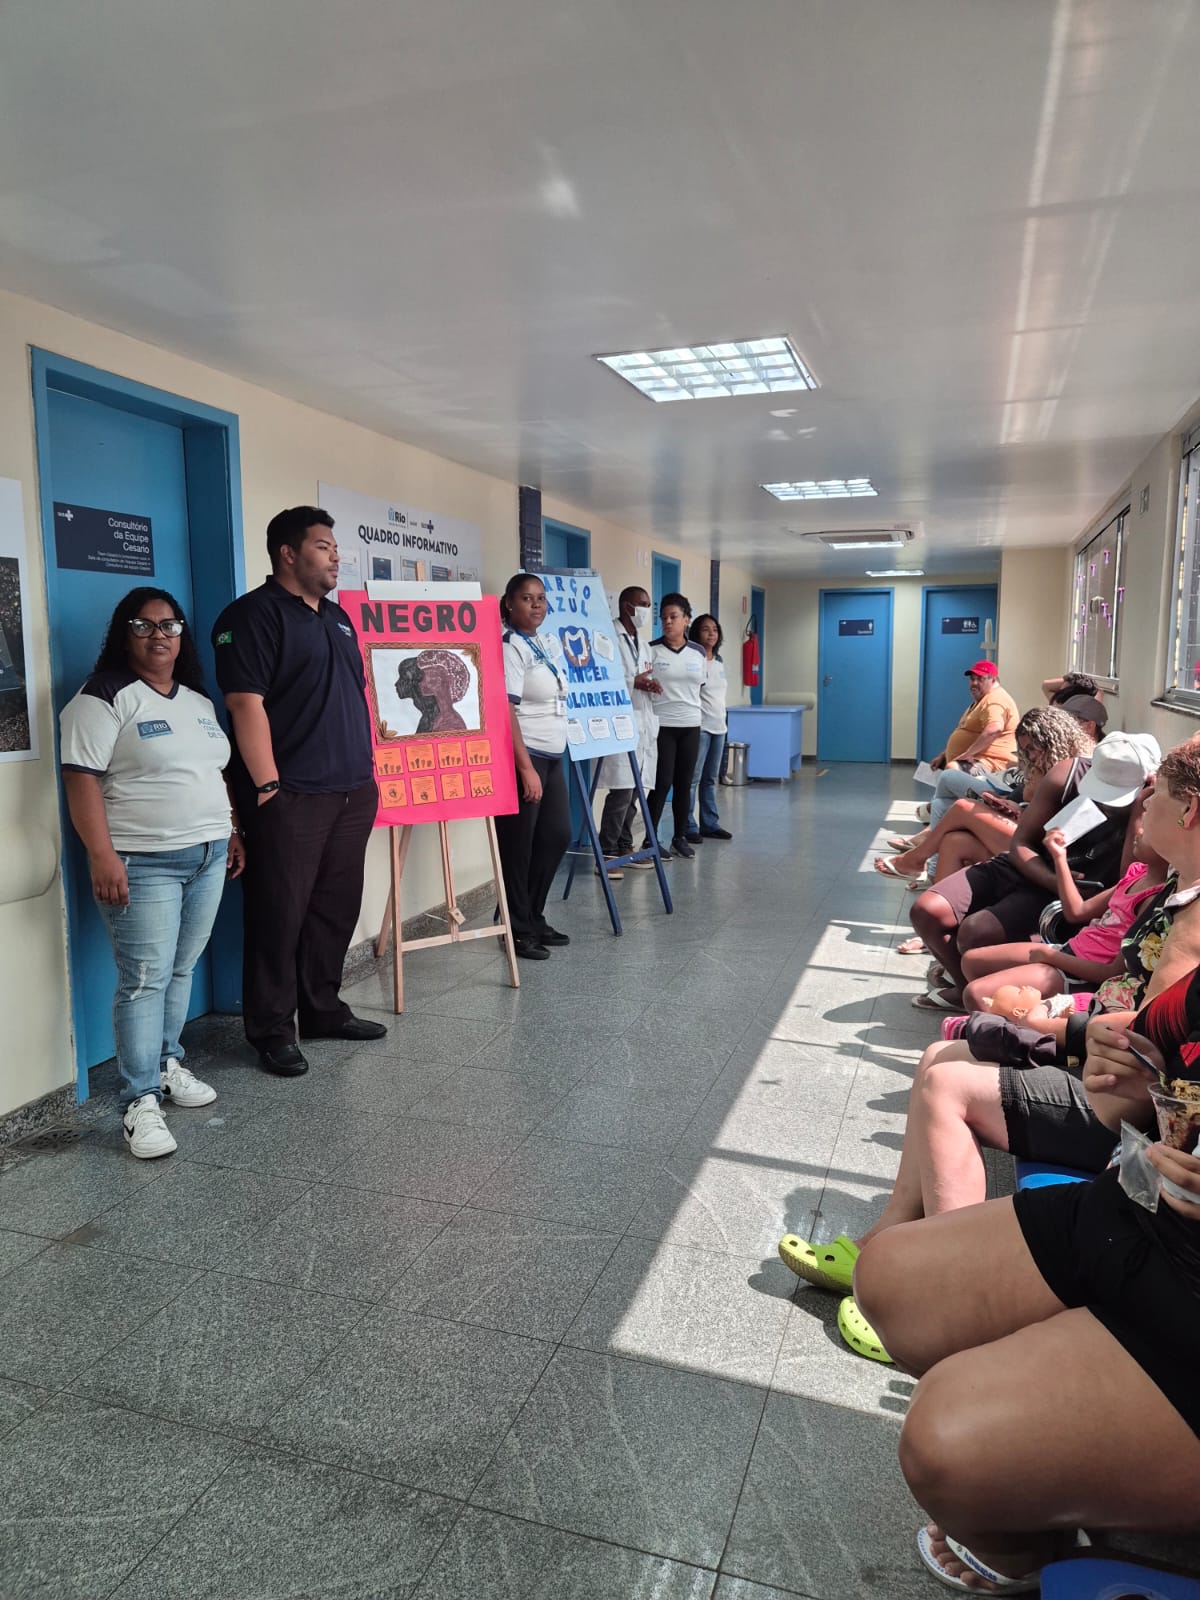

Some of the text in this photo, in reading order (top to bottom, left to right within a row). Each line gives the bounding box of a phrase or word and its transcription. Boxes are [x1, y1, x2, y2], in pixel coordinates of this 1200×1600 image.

[107, 517, 149, 532] Consultório
[113, 529, 149, 544] da Equipe
[358, 524, 458, 556] QUADRO INFORMATIVO
[543, 576, 591, 600] ARÇO
[360, 601, 477, 633] NEGRO
[567, 689, 631, 710] OLORRETAL
